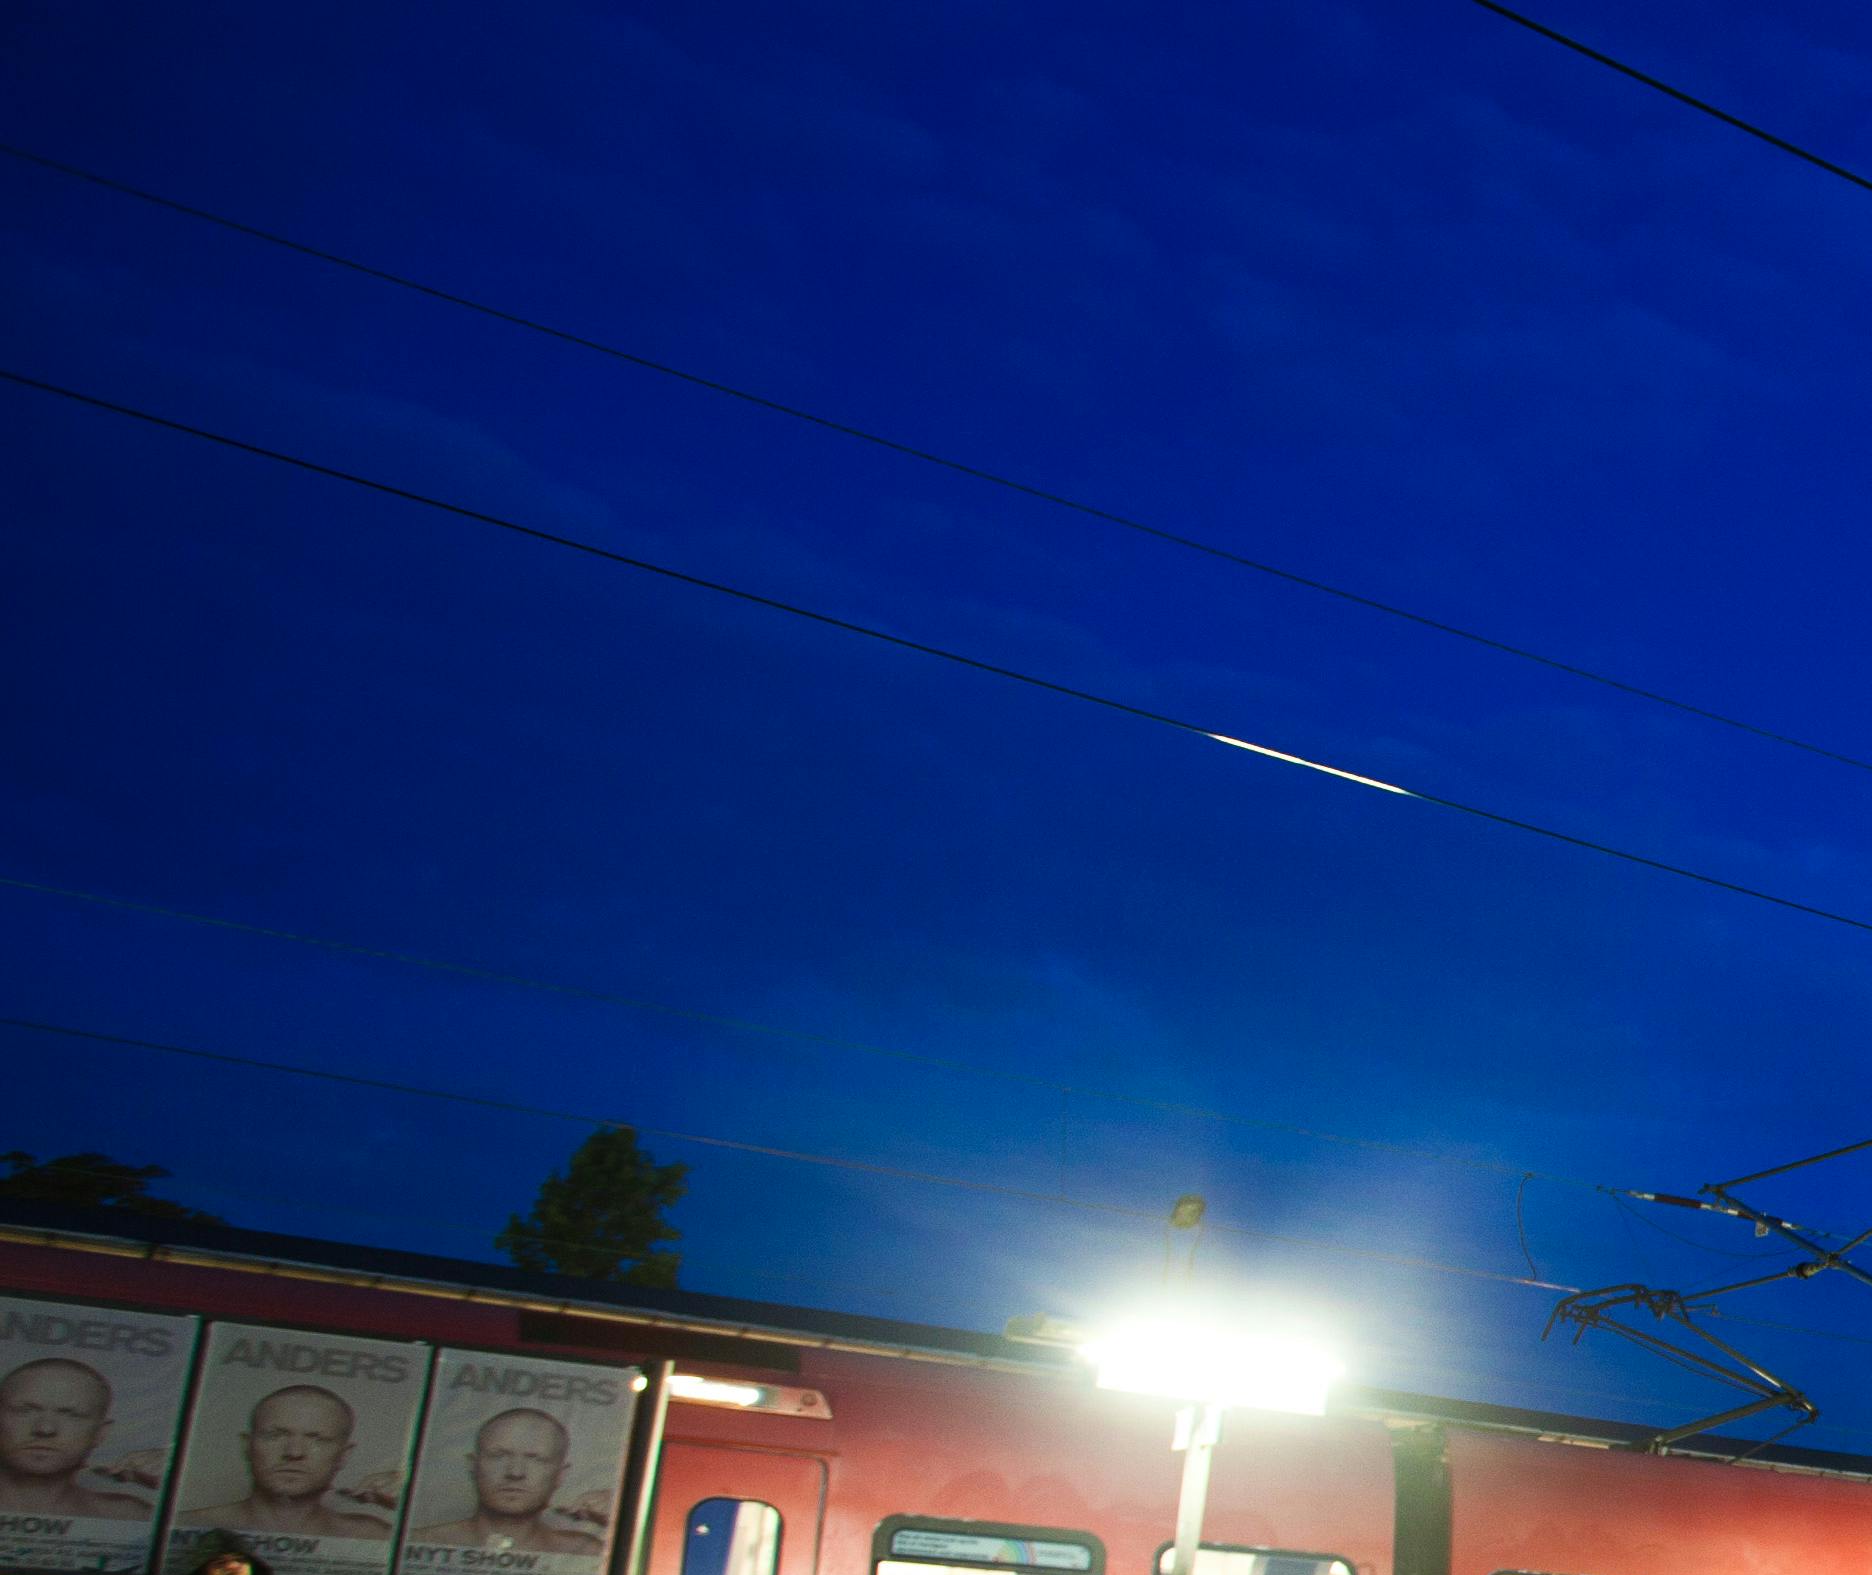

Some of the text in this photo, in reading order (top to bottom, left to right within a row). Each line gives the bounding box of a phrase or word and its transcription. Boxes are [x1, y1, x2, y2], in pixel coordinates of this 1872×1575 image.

[0, 1311, 173, 1356] NDERS
[222, 1338, 409, 1383] ANDERS
[450, 1363, 618, 1405] ANDERS
[0, 1514, 73, 1535] HOW
[252, 1533, 320, 1553] HOW
[404, 1545, 539, 1569] NYT SHOW
